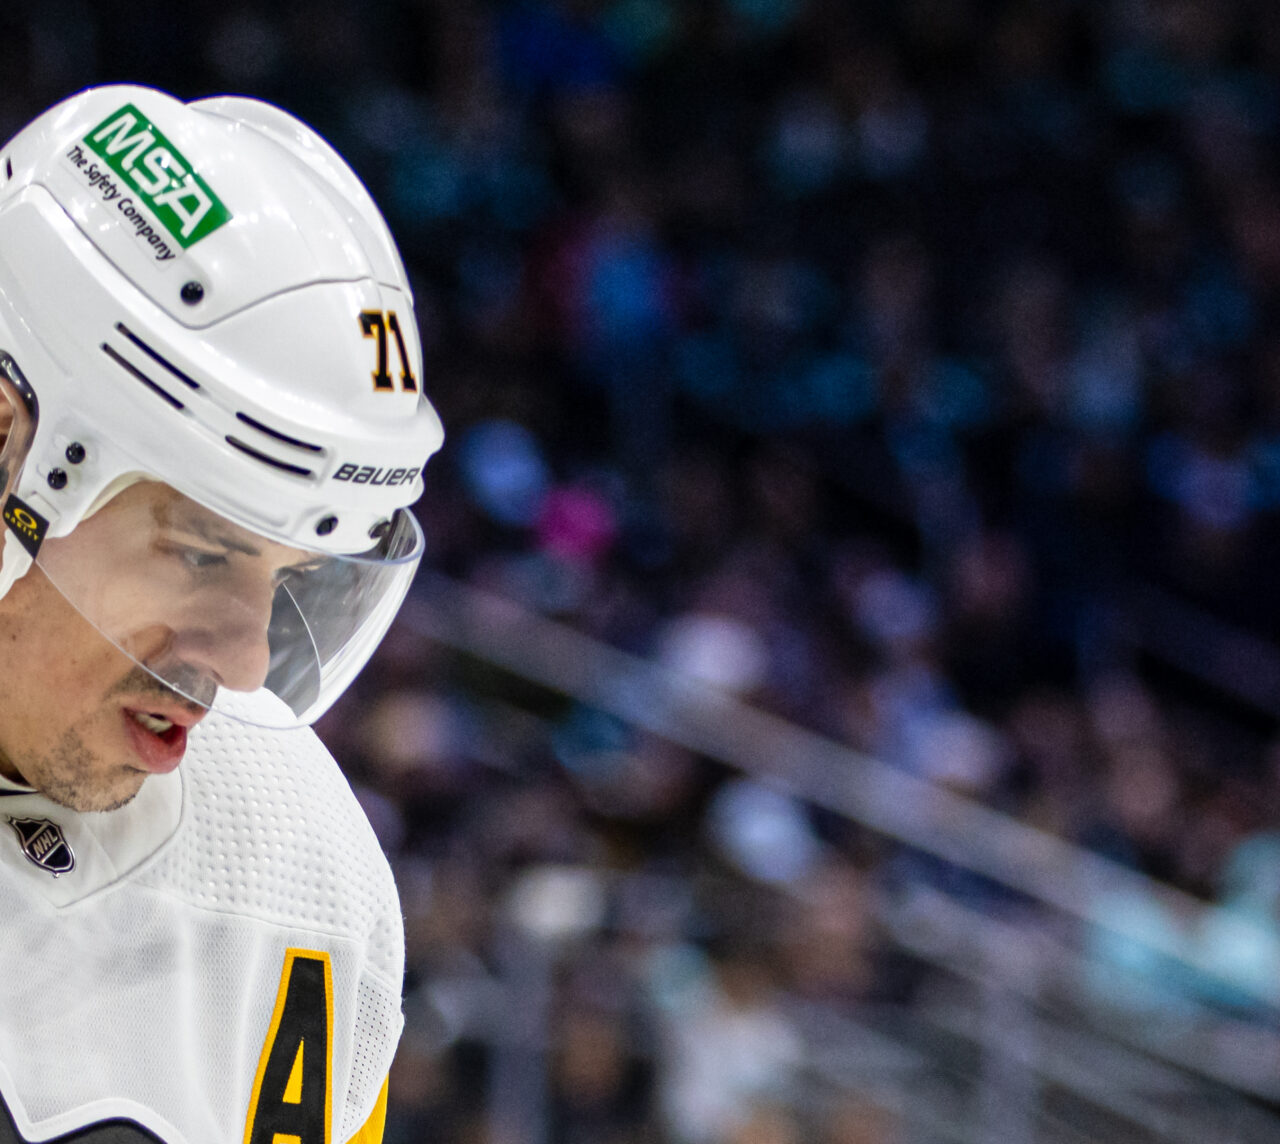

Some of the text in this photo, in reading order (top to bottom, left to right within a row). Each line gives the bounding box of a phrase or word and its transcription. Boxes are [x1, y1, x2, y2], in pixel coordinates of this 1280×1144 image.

[67, 145, 176, 261] The Safety Company
[92, 111, 214, 239] MSA
[357, 309, 418, 394] 71
[32, 828, 58, 860] NHL
